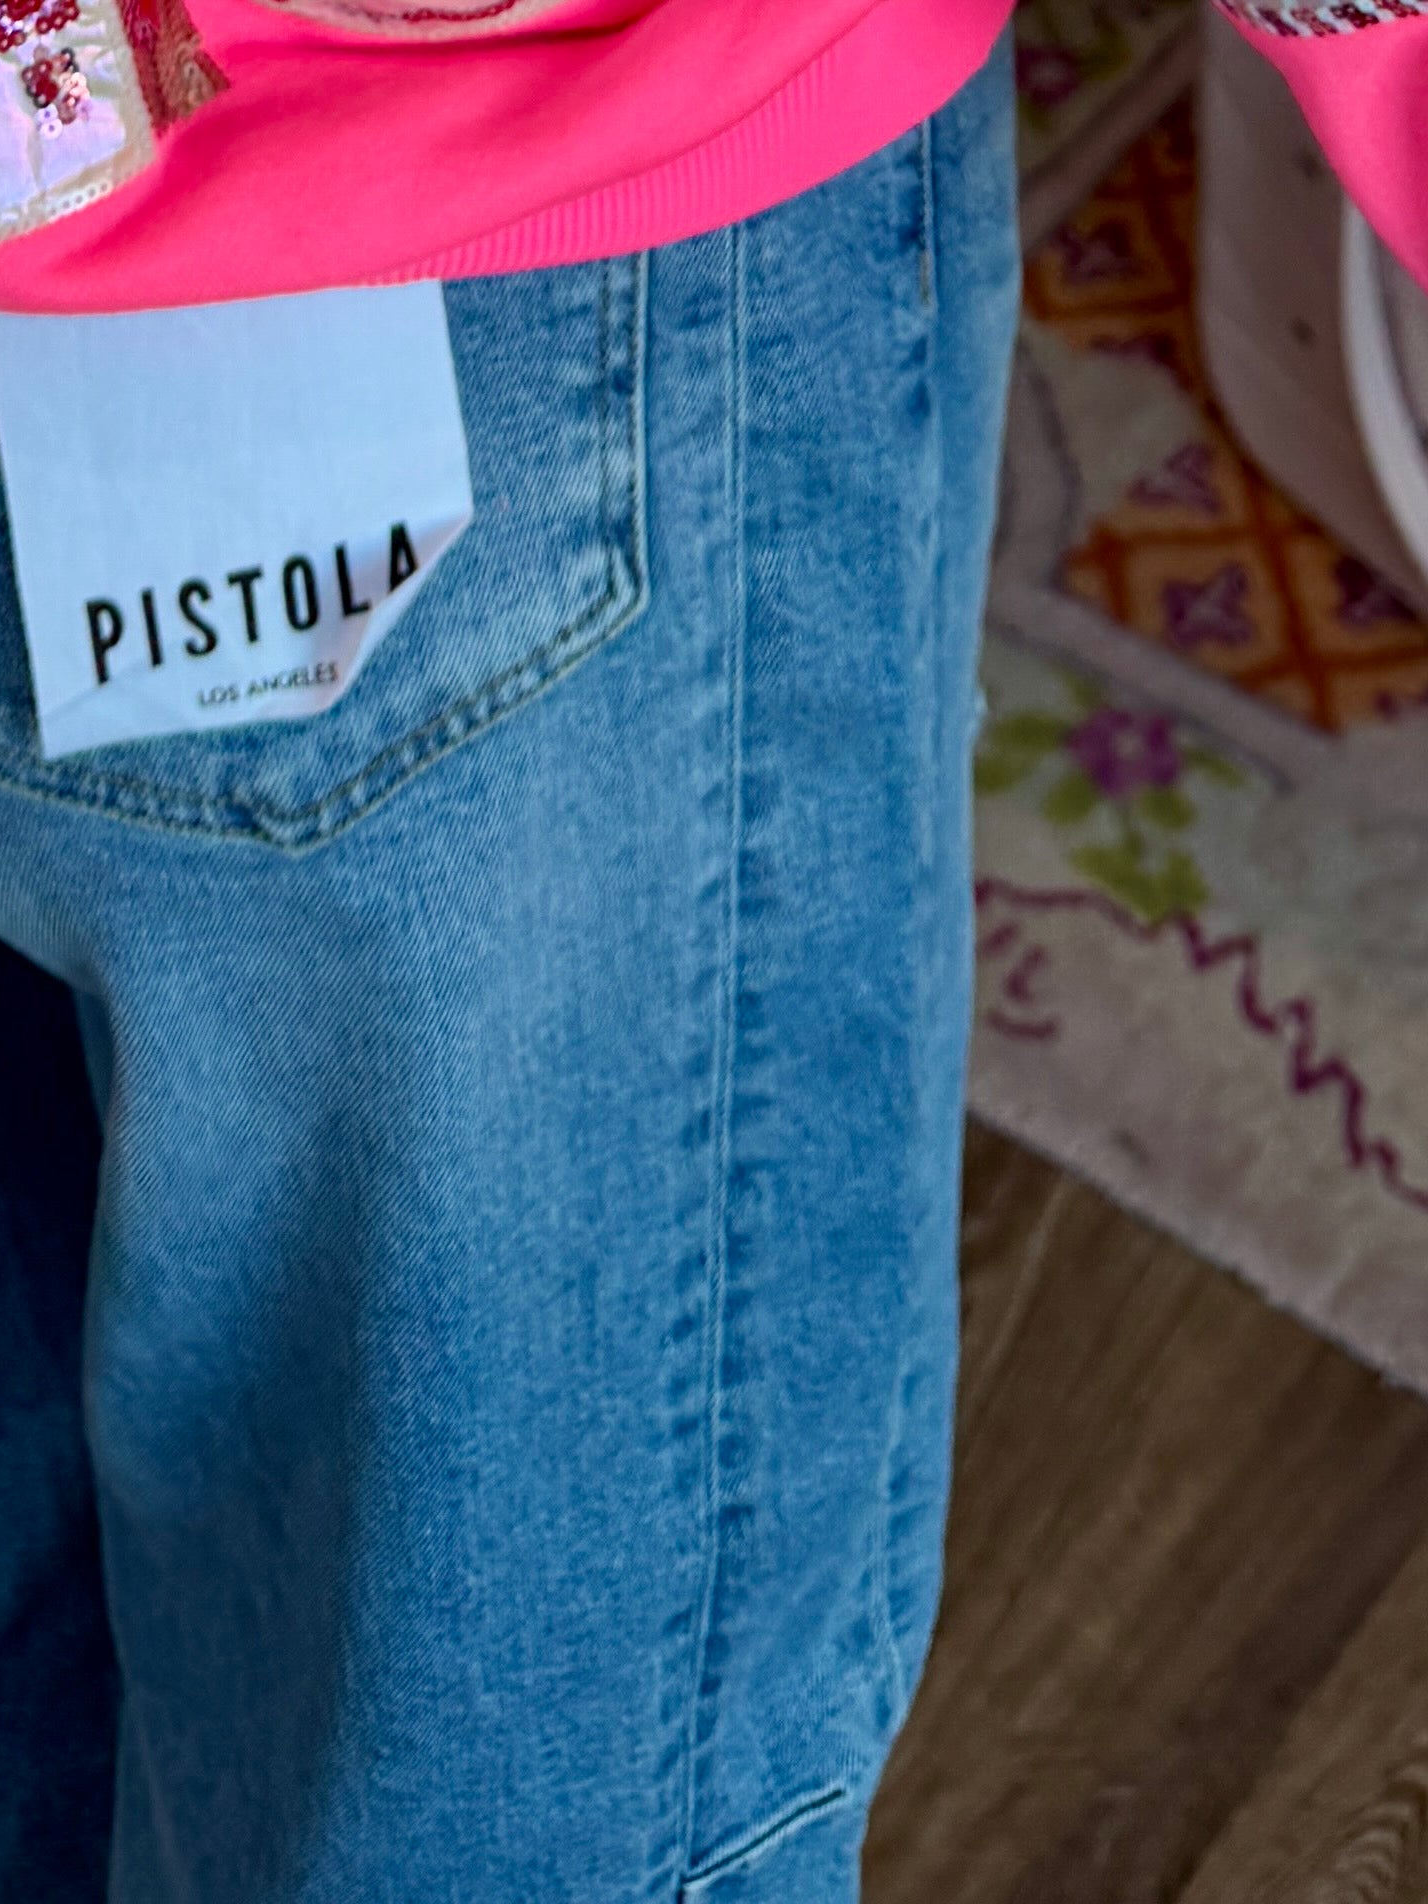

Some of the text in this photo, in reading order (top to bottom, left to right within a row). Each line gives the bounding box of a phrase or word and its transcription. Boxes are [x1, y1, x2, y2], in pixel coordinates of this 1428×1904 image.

[83, 519, 421, 686] PISTOLA
[196, 660, 340, 708] LOS ANGELES
